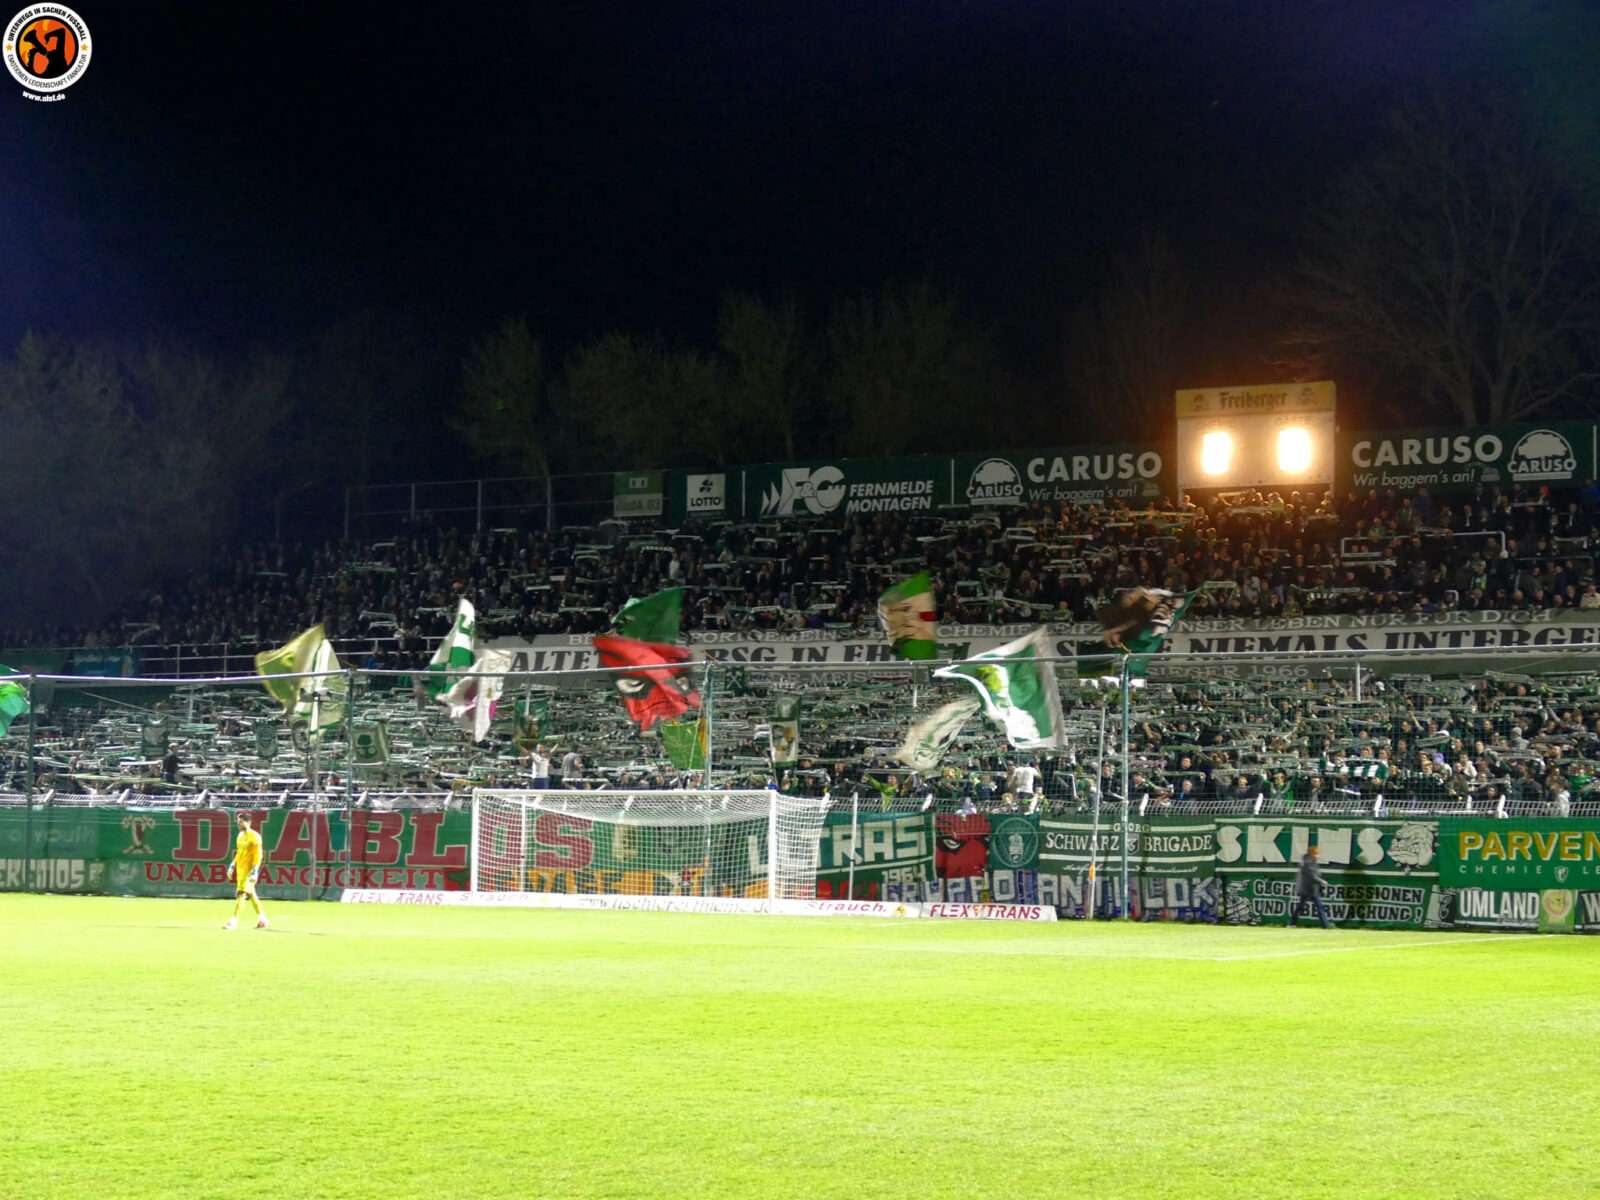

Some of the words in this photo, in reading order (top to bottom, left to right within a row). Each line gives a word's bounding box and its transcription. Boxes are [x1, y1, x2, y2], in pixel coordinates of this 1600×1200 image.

[1219, 391, 1288, 411] Freiberger
[1352, 434, 1503, 468] CARUSO
[1027, 452, 1163, 483] CARUSO
[1507, 459, 1577, 474] CARUSO
[1353, 474, 1379, 487] Wir
[1382, 469, 1448, 489] baggern's
[1452, 469, 1476, 483] an!
[850, 480, 934, 498] FERNMELDE
[966, 484, 1024, 499] CARUSO
[1029, 489, 1050, 501] Wir
[1117, 485, 1138, 498] an!
[690, 497, 721, 507] LOTTO
[847, 496, 932, 513] MONTAGEN
[1177, 619, 1245, 633] NSER
[1254, 615, 1341, 631] LEBEN
[1350, 612, 1408, 627] NUR
[1482, 608, 1552, 625] DICH
[1190, 633, 1368, 658] NIEMALS
[791, 646, 830, 665] IN
[1252, 663, 1308, 678] 1966
[1113, 822, 1149, 833] GORG
[1143, 834, 1212, 852] BRIGADE
[1216, 825, 1384, 866] SKINS
[1459, 865, 1543, 874] CHEMIE
[1318, 884, 1425, 904] EPRESSIONEN
[930, 904, 973, 918] FLEX
[987, 905, 1041, 920] TRANS
[1253, 899, 1285, 916] UND
[1460, 890, 1541, 919] UMLAND
